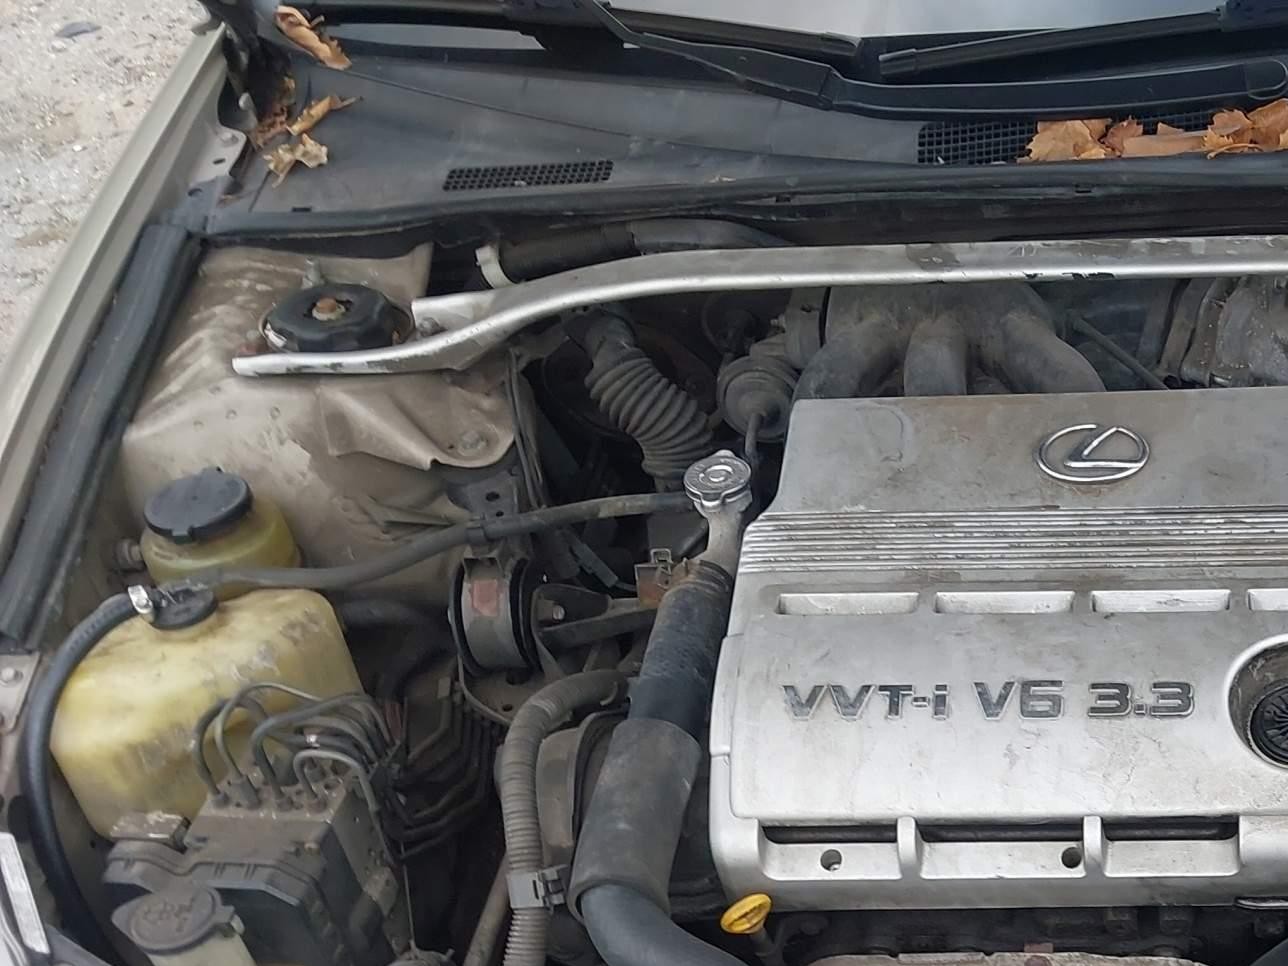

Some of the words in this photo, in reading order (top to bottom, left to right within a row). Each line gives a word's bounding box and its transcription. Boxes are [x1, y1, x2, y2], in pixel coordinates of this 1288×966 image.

[782, 683, 950, 721] VVT-i
[972, 680, 1065, 721] V6
[1088, 681, 1196, 719] 3.3
